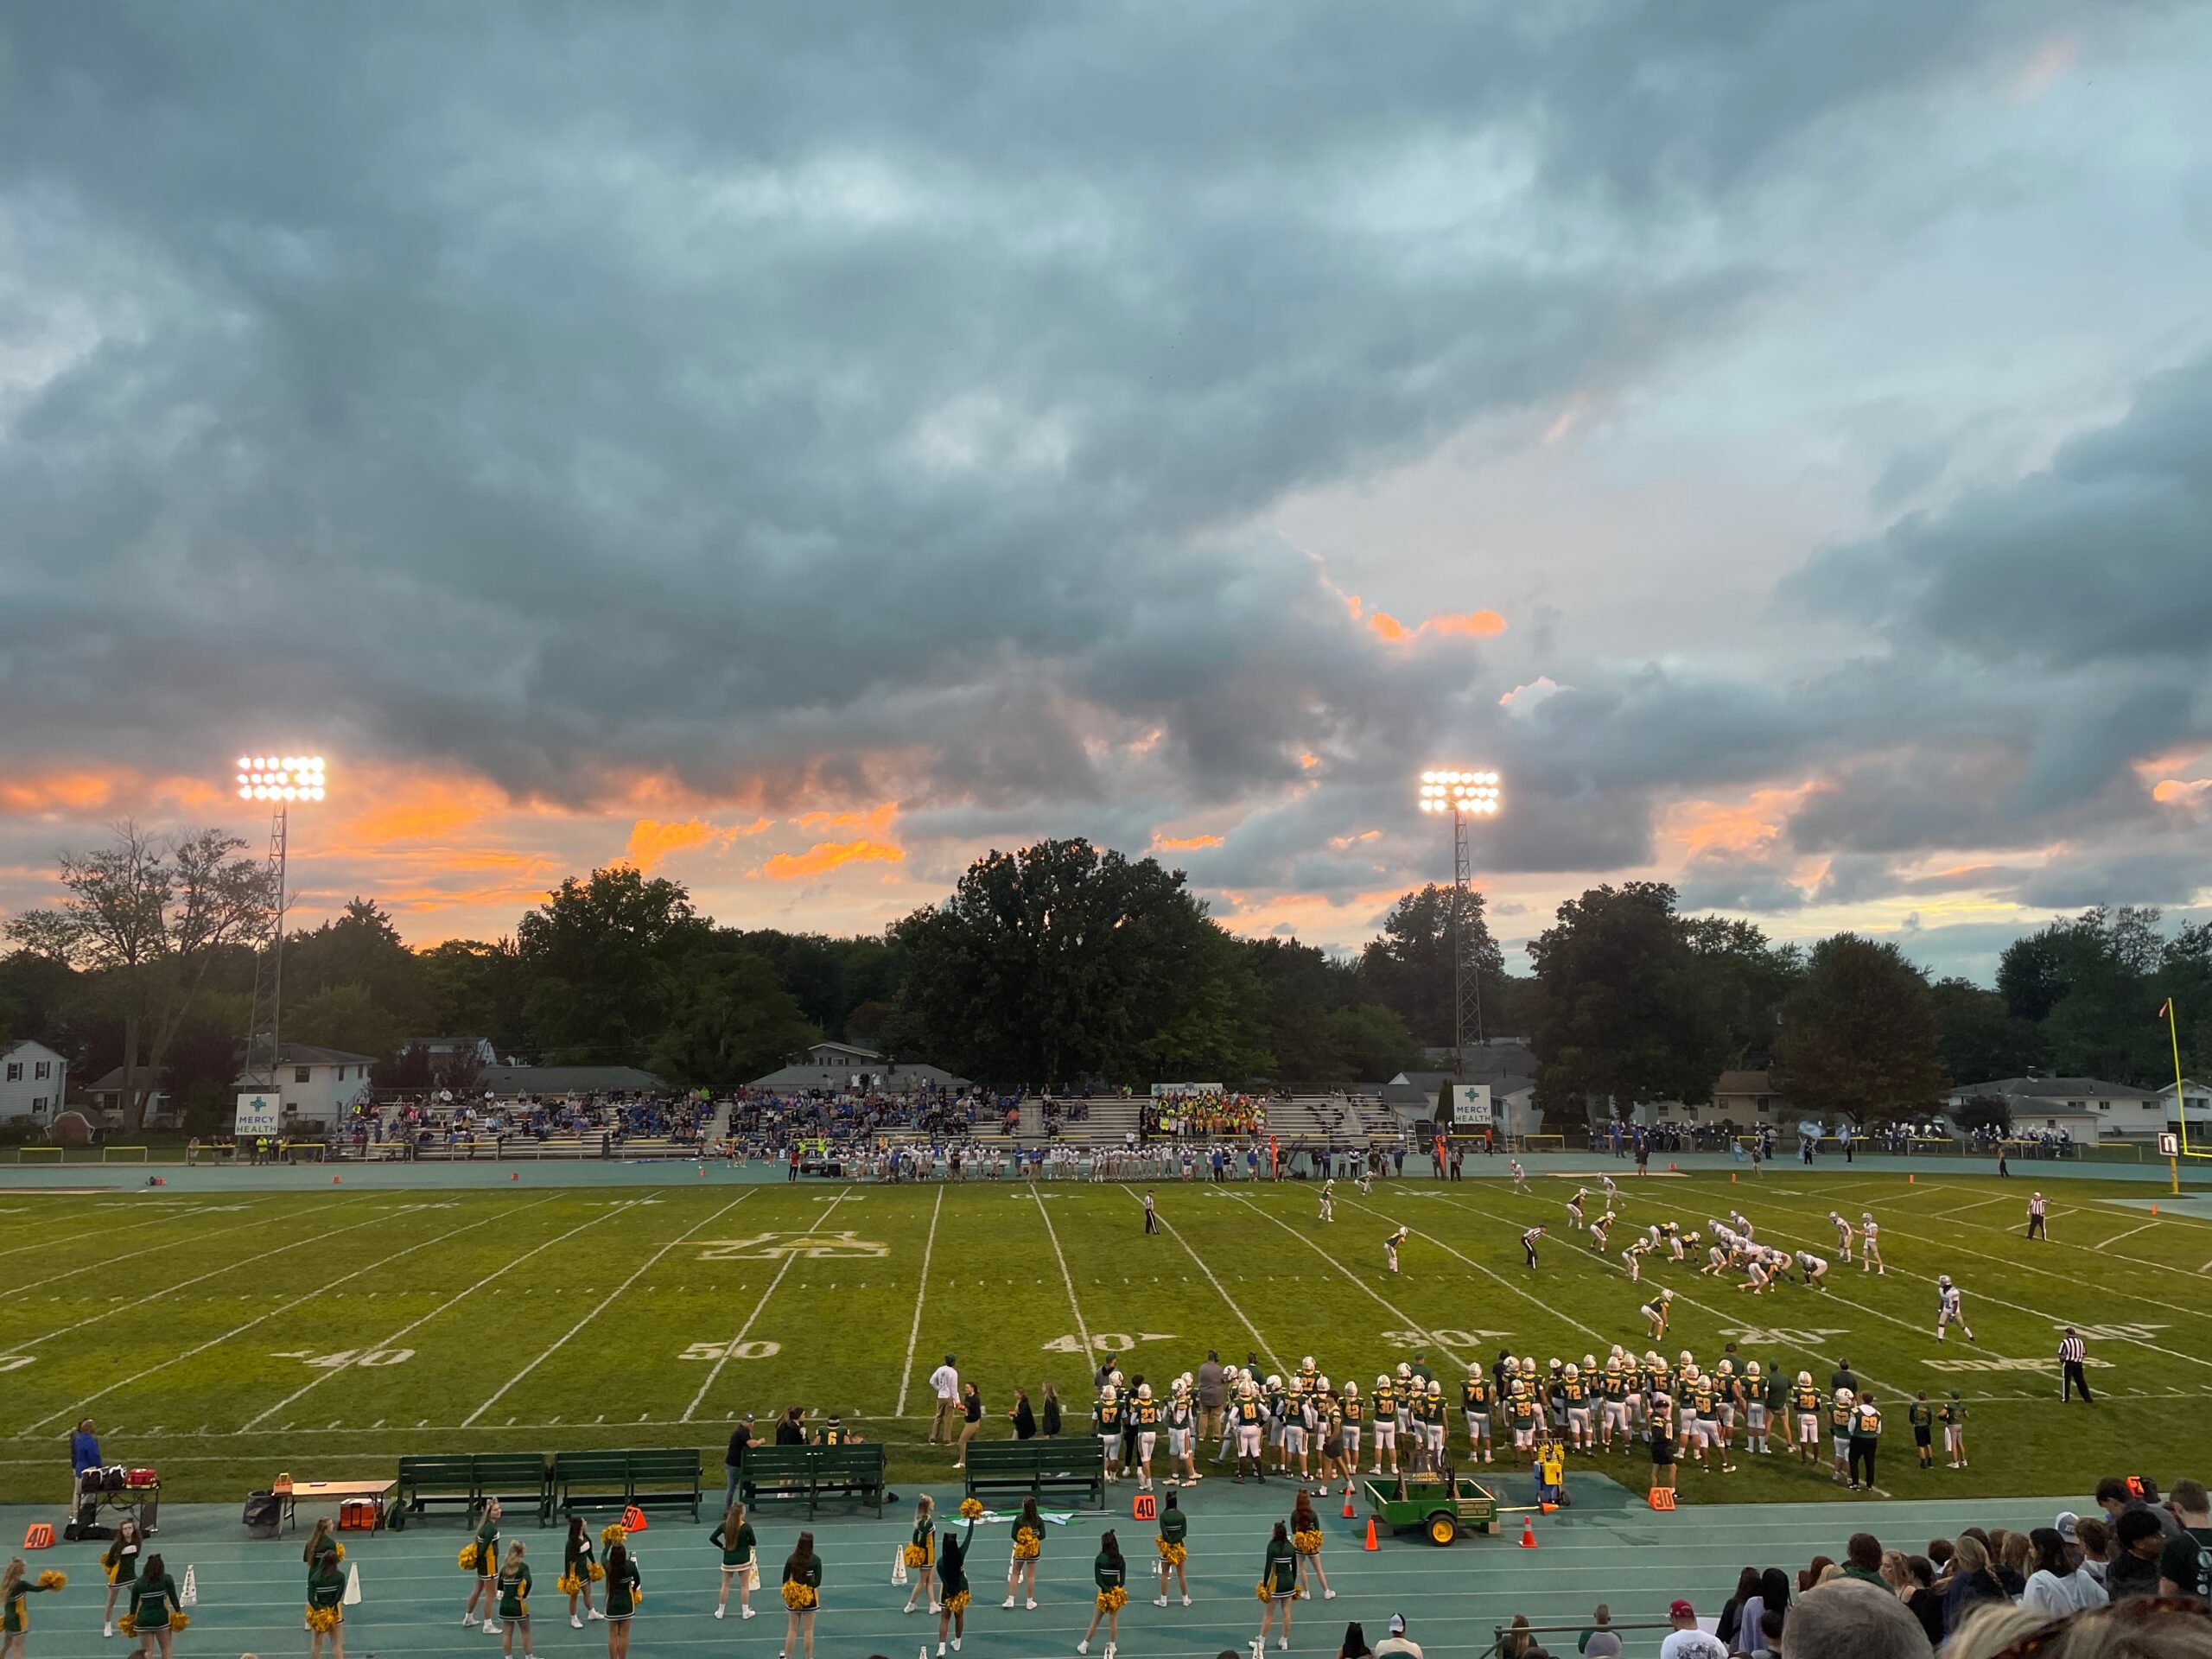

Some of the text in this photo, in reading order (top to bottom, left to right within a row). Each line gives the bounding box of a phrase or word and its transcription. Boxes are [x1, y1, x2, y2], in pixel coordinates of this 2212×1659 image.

[1041, 1333, 1135, 1353] 40
[1381, 1329, 1481, 1349] 30
[1718, 1328, 1826, 1344] 20
[302, 1348, 416, 1368] 40
[677, 1340, 782, 1360] 50
[1606, 1378, 1622, 1394] 77
[1654, 1376, 1668, 1390] 15
[1751, 1383, 1759, 1398] 4
[1468, 1387, 1484, 1402] 78
[1565, 1385, 1582, 1400] 72
[1243, 1403, 1257, 1420] 81
[1284, 1399, 1300, 1415] 73
[1379, 1400, 1394, 1414] 30
[1428, 1403, 1436, 1418] 7
[1516, 1402, 1531, 1416] 59
[1694, 1395, 1711, 1413] 58
[1102, 1408, 1118, 1423] 67
[1141, 1408, 1155, 1424] 23
[1833, 1410, 1849, 1425] 62
[1860, 1415, 1878, 1432] 69
[827, 1431, 837, 1446] 6
[1653, 1489, 1674, 1508] 30
[1136, 1498, 1155, 1518] 40
[621, 1508, 639, 1529] 50
[27, 1527, 50, 1548] 40
